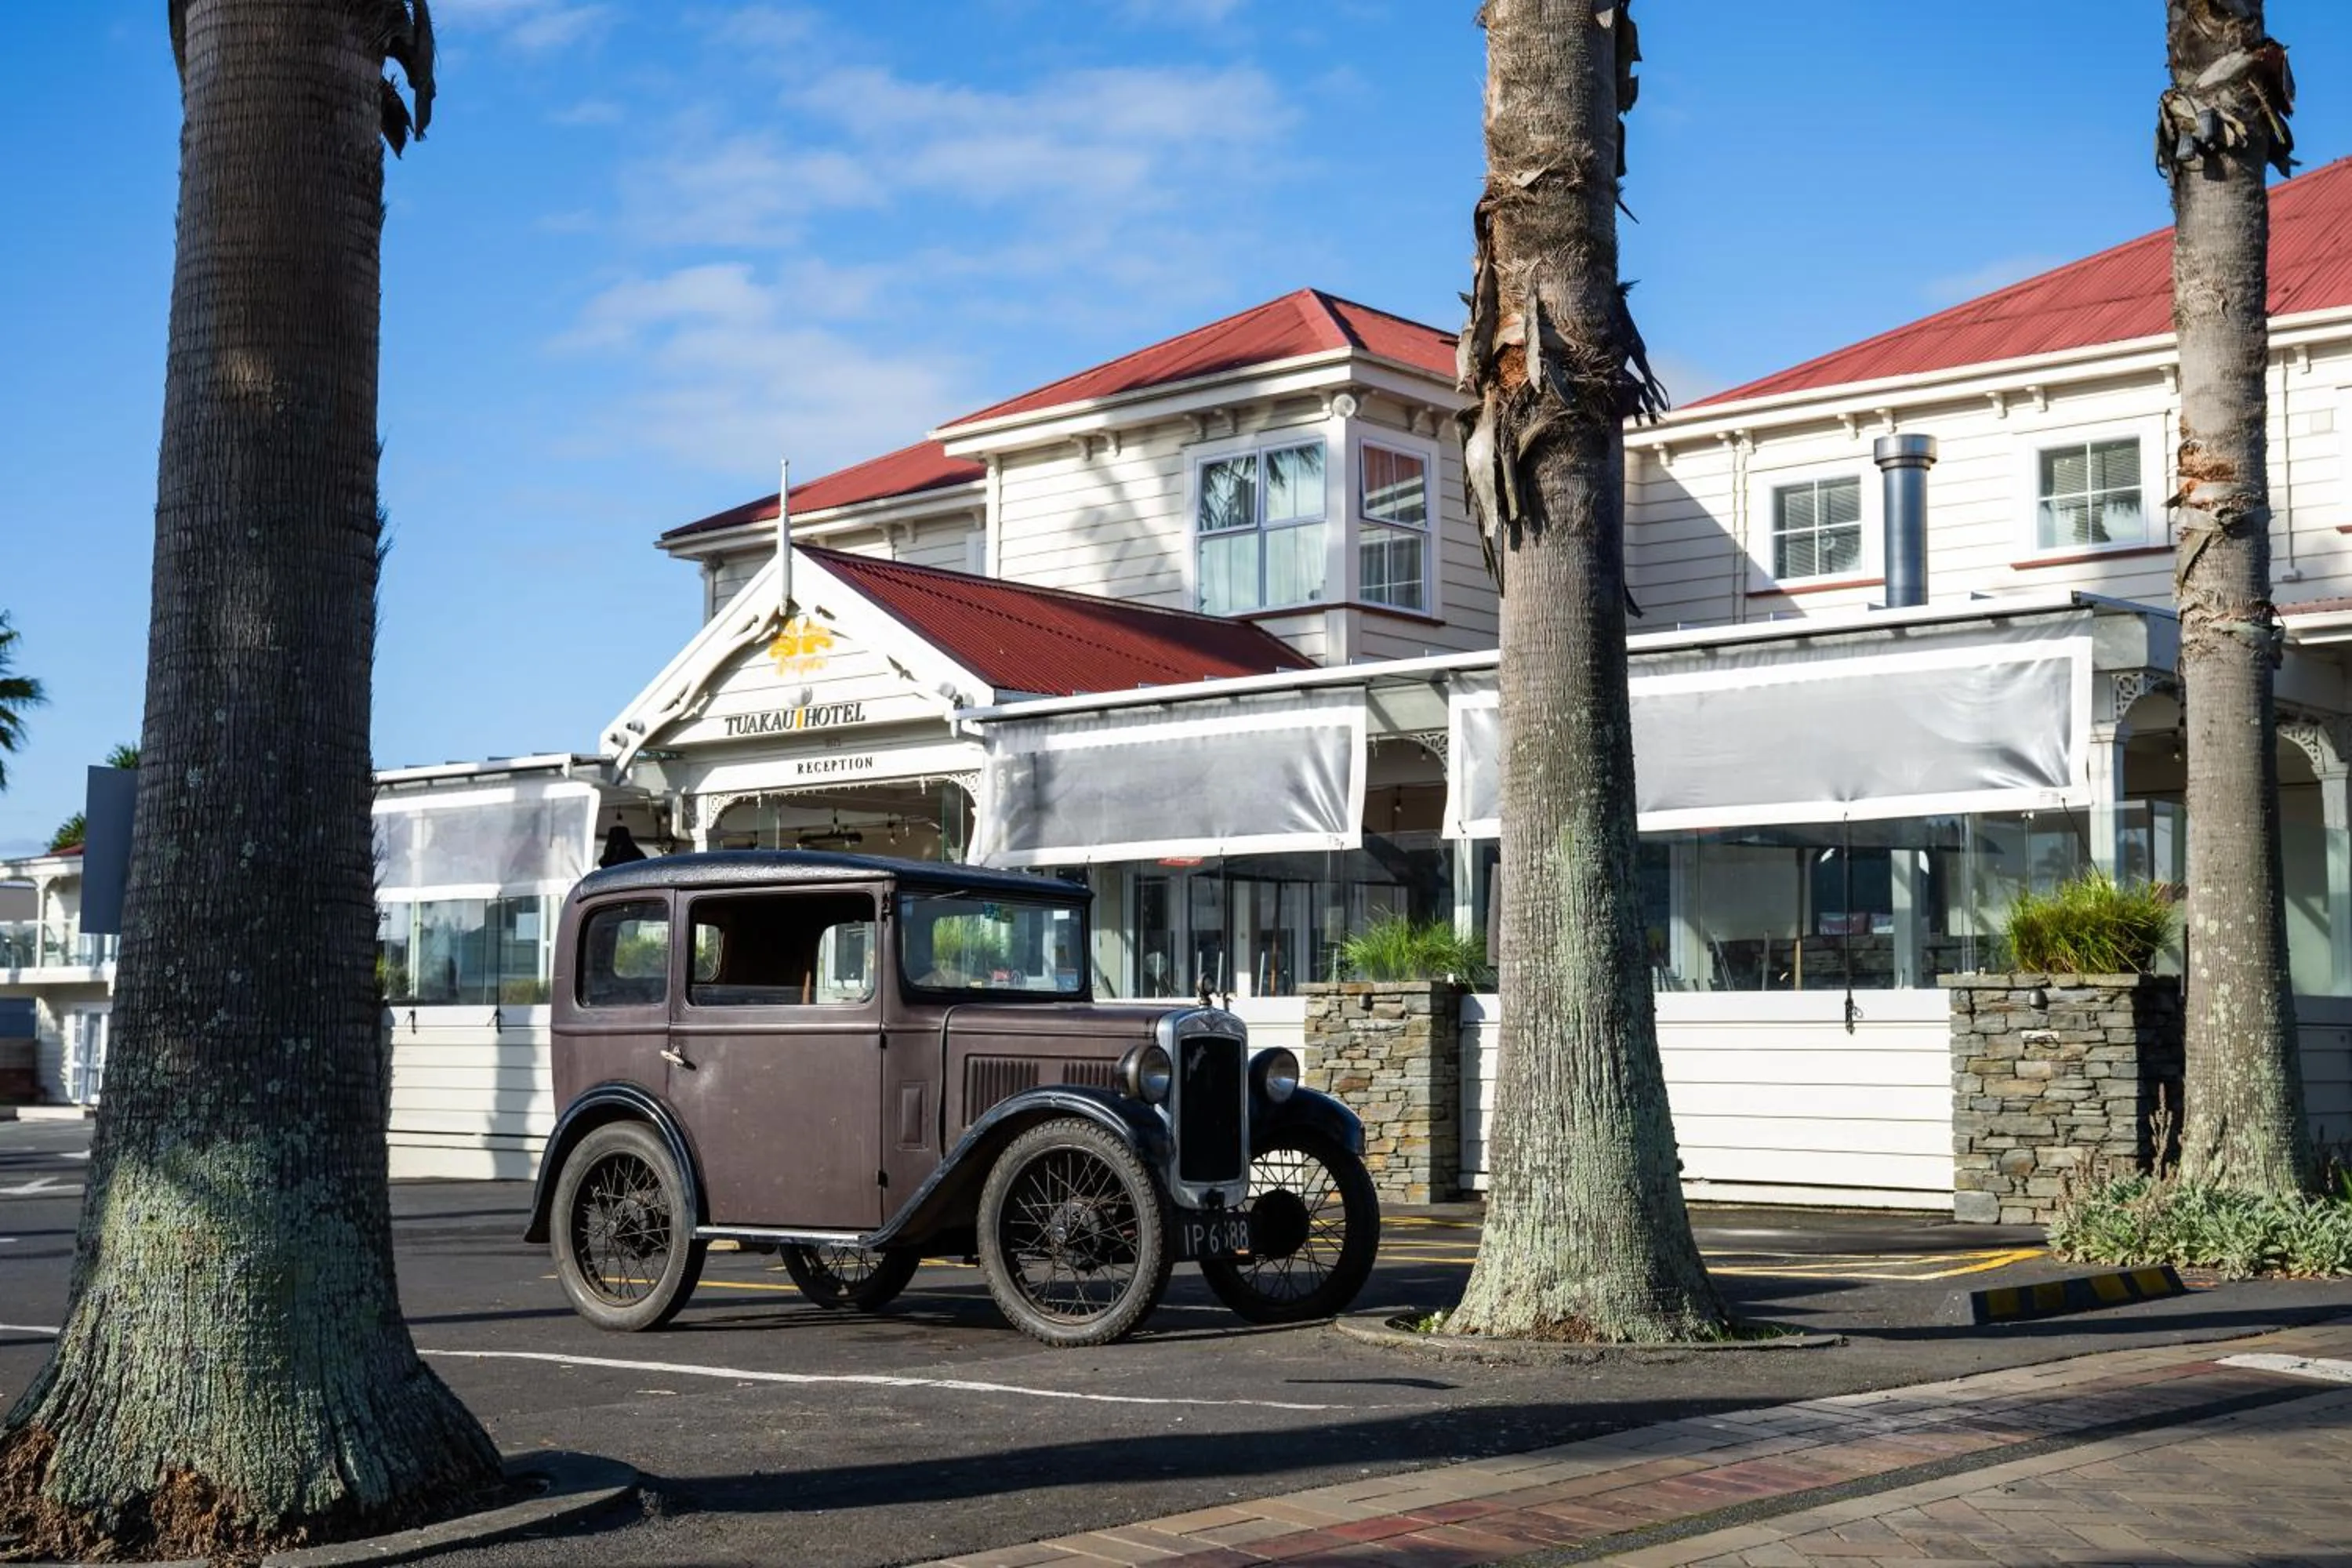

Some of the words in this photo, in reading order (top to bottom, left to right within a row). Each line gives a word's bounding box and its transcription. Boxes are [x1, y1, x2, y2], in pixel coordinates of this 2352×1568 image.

[725, 708, 795, 735] TUAKAU
[804, 702, 866, 728] HOTEL
[797, 757, 873, 774] RECEPTION
